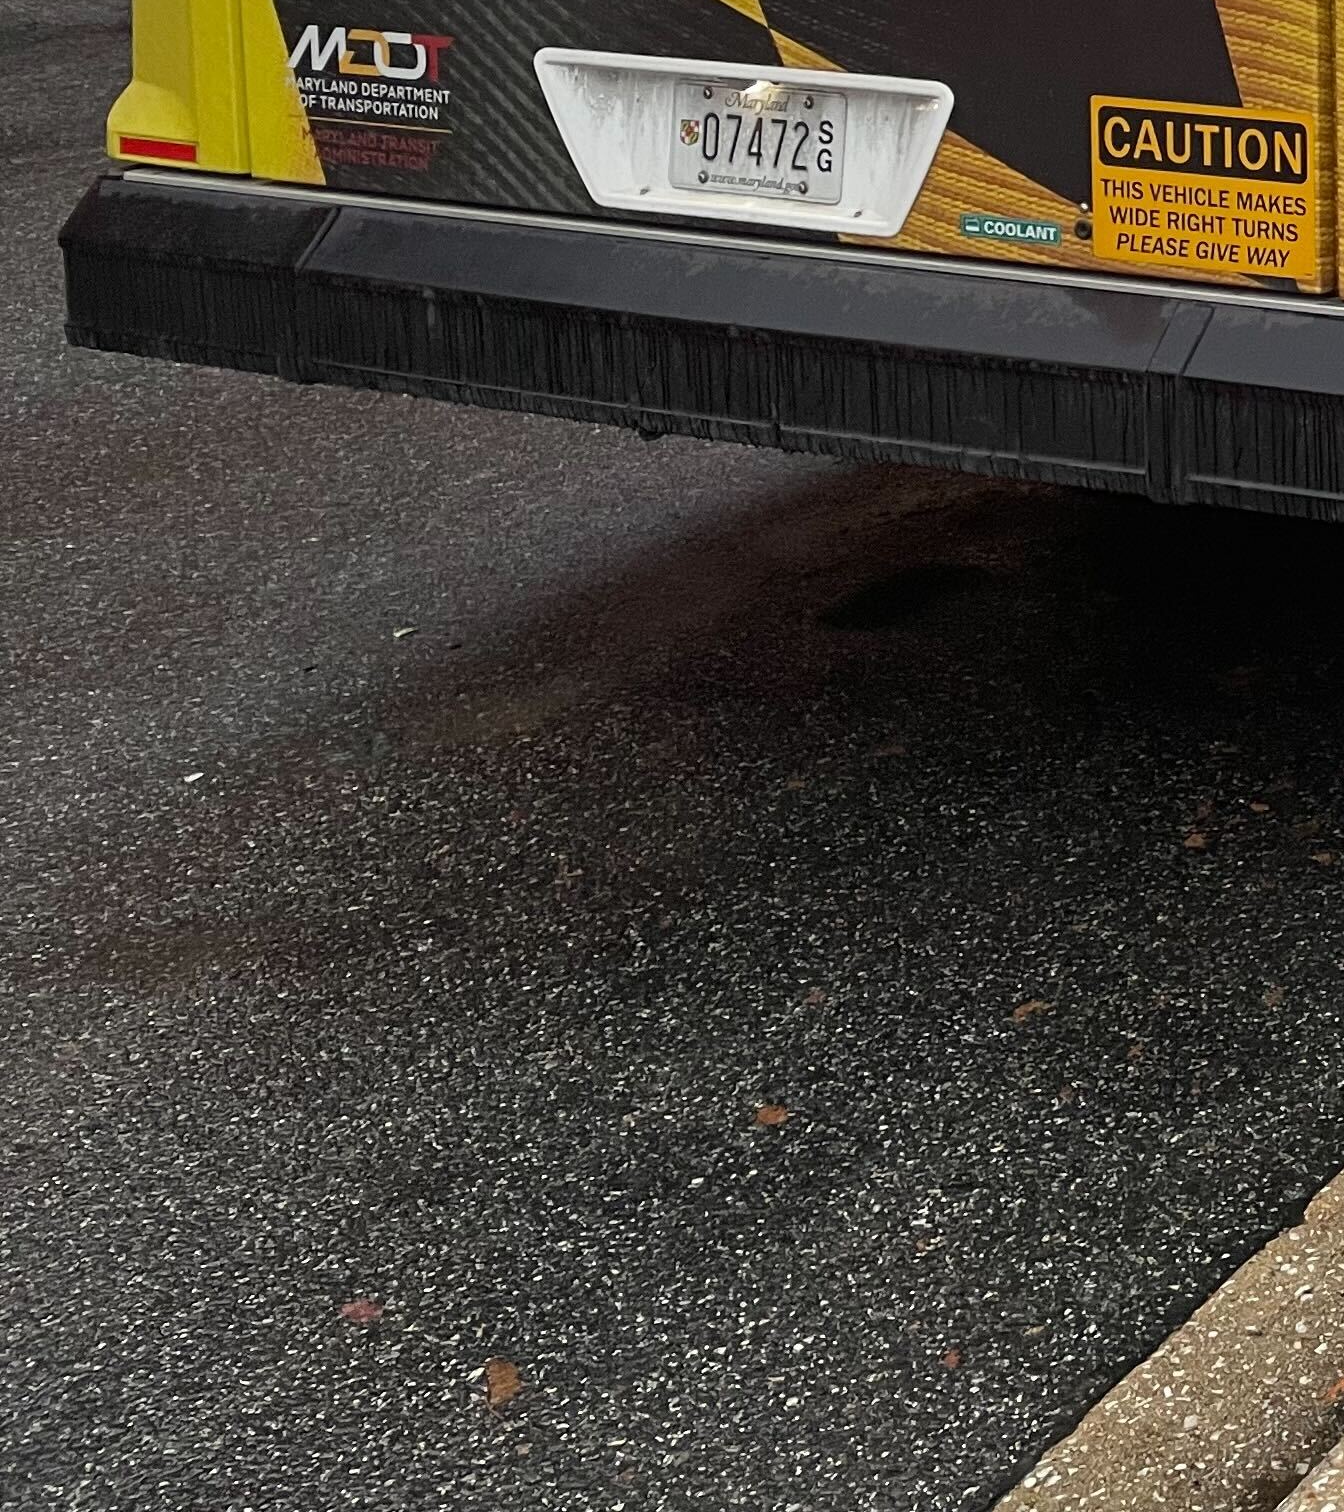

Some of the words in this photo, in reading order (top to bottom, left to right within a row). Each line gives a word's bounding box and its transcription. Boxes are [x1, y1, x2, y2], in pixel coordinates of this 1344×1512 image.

[287, 24, 456, 84] MDOT
[299, 94, 317, 108] OF
[319, 95, 439, 121] TRANSPORTATION
[361, 82, 450, 105] DEPARTMENT
[724, 91, 791, 116] Maryland
[702, 112, 810, 172] 07472
[1103, 115, 1302, 175] CAUTION
[1100, 178, 1144, 200] THIS
[1149, 183, 1230, 209] VEHICLE
[1236, 191, 1307, 217] MAKES
[983, 220, 1057, 241] COOLANT
[1109, 205, 1161, 228] WIDE
[1167, 211, 1227, 235] RIGHT
[1231, 217, 1299, 242] TURNS
[1116, 232, 1190, 258] PLEASE
[1195, 241, 1240, 263] GIVE
[1247, 246, 1291, 268] WAY
